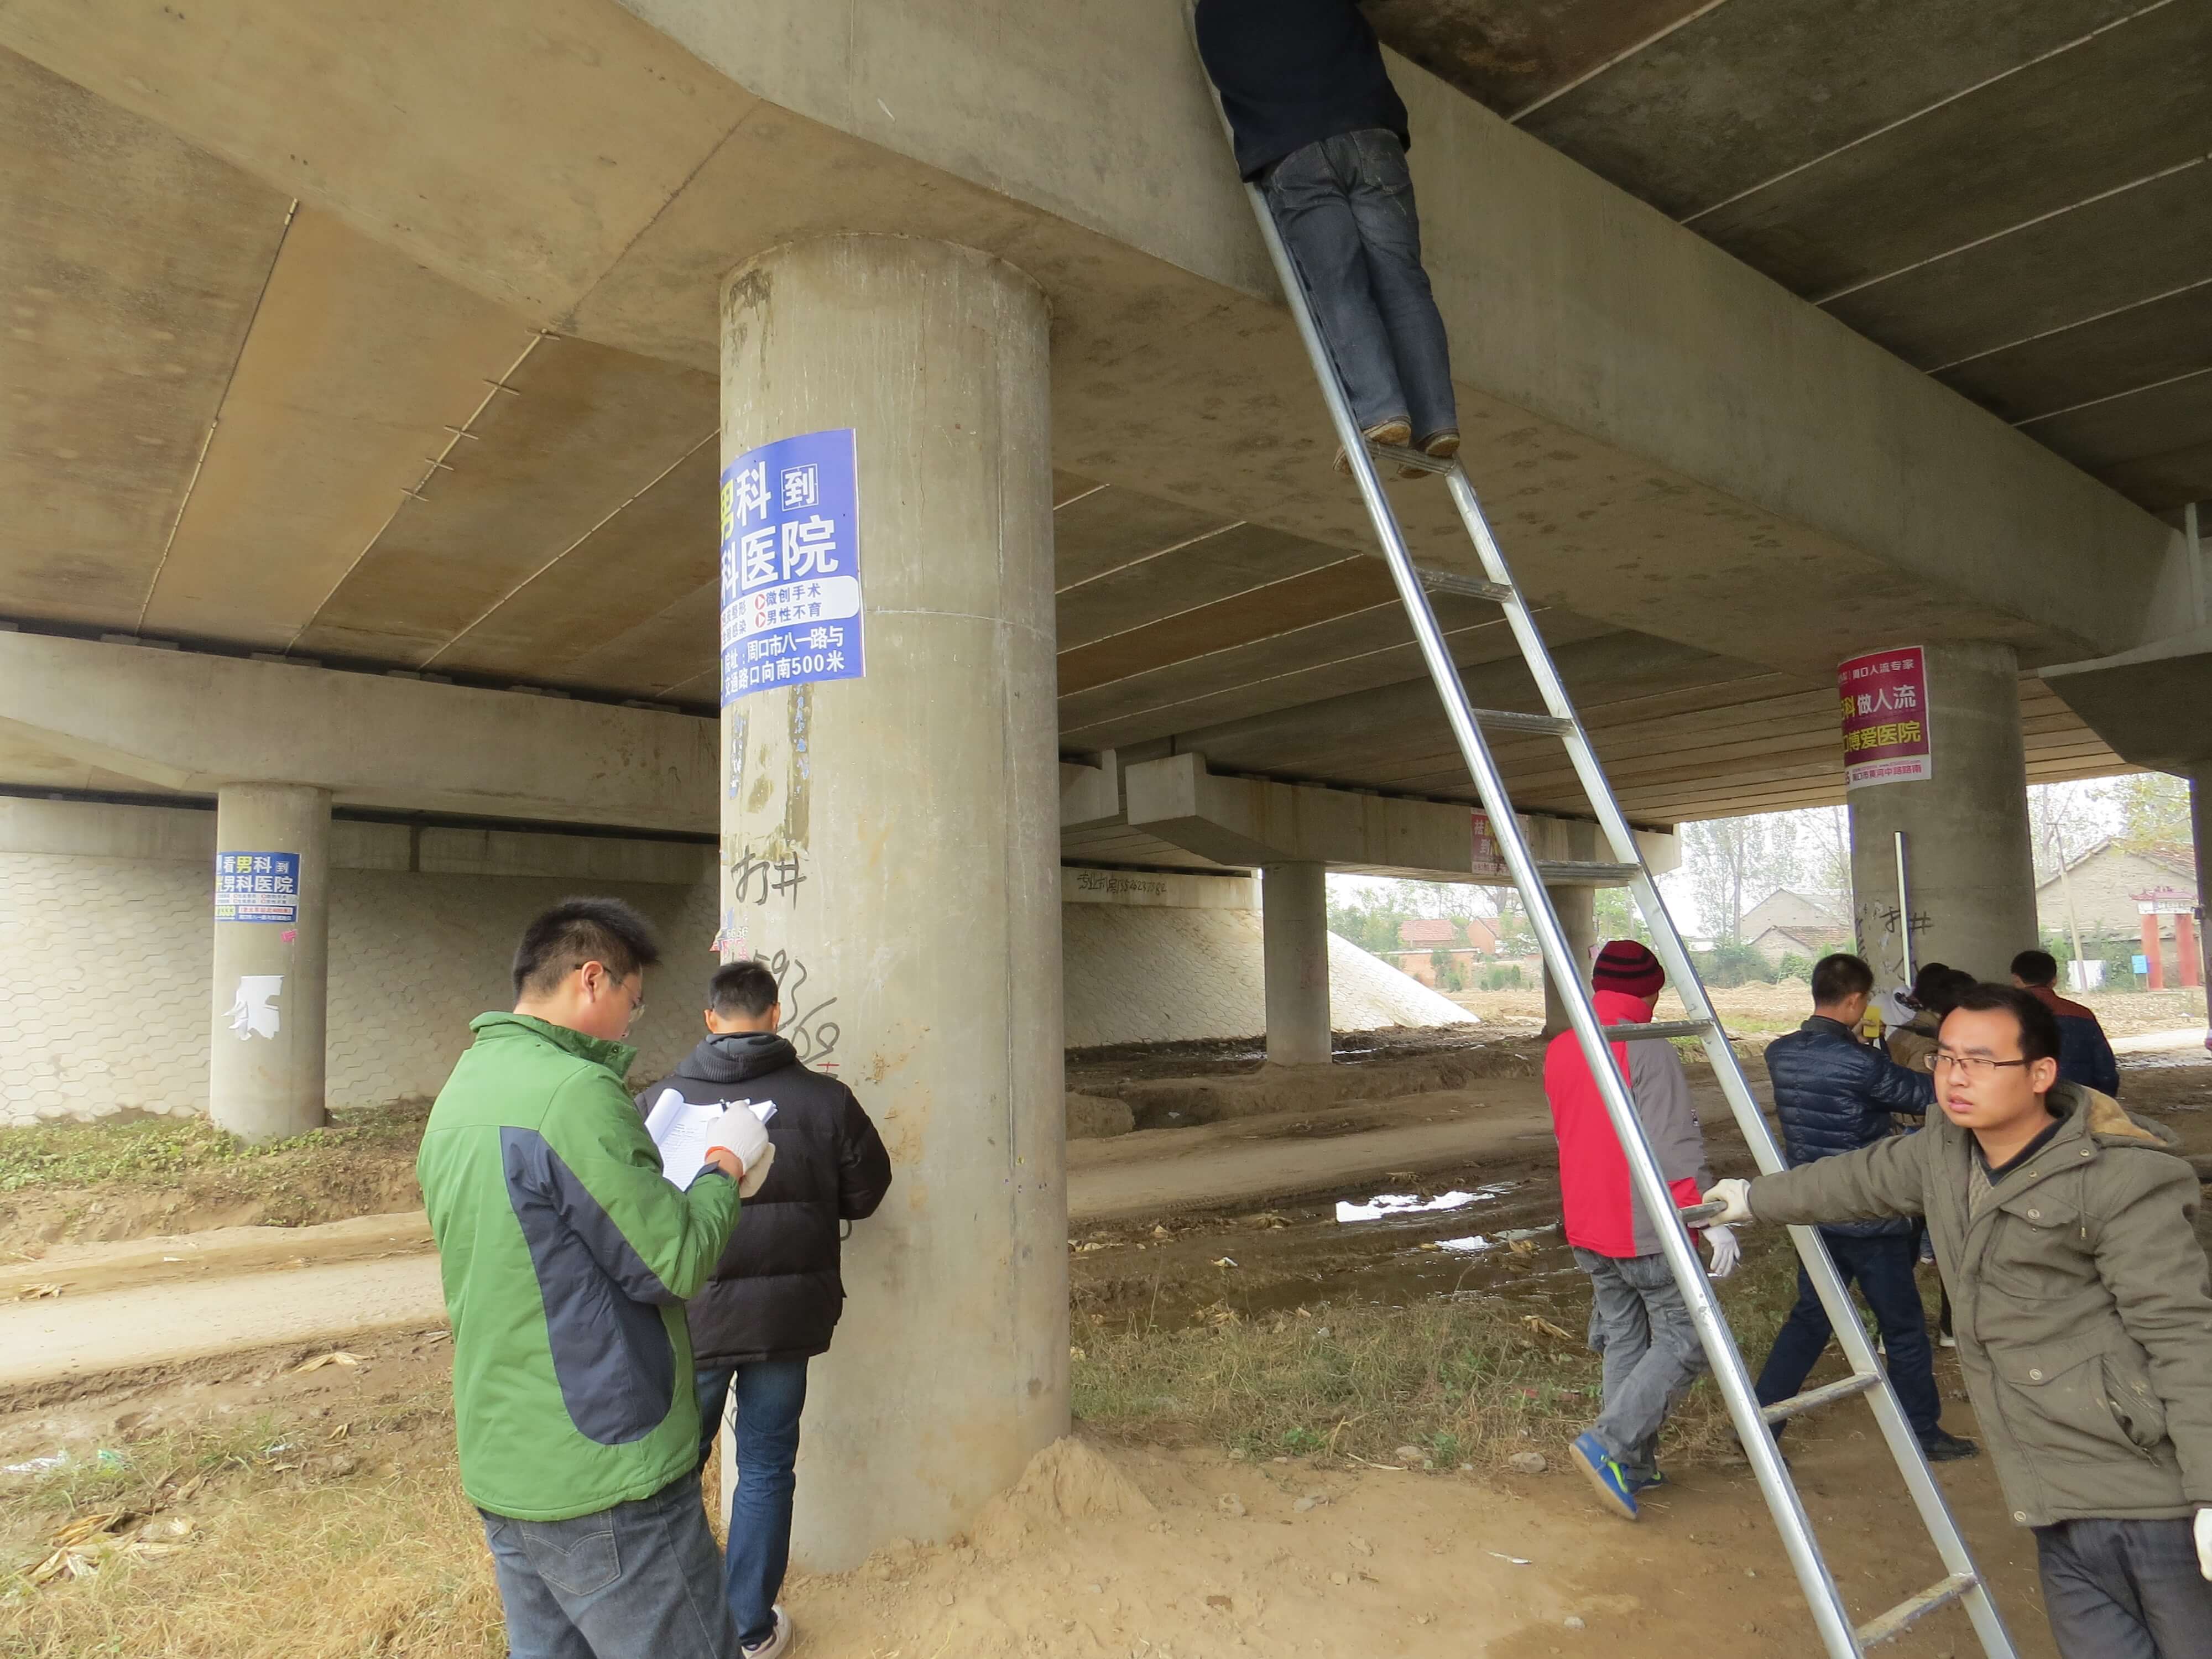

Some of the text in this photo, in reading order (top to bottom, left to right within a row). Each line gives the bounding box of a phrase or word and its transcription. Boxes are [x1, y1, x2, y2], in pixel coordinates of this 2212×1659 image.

[721, 461, 815, 547] 男科 到
[721, 514, 839, 607] 科医院
[766, 583, 821, 607] 微创手术
[767, 602, 822, 625] 男性不育
[724, 650, 845, 698] 交通路口向南500米
